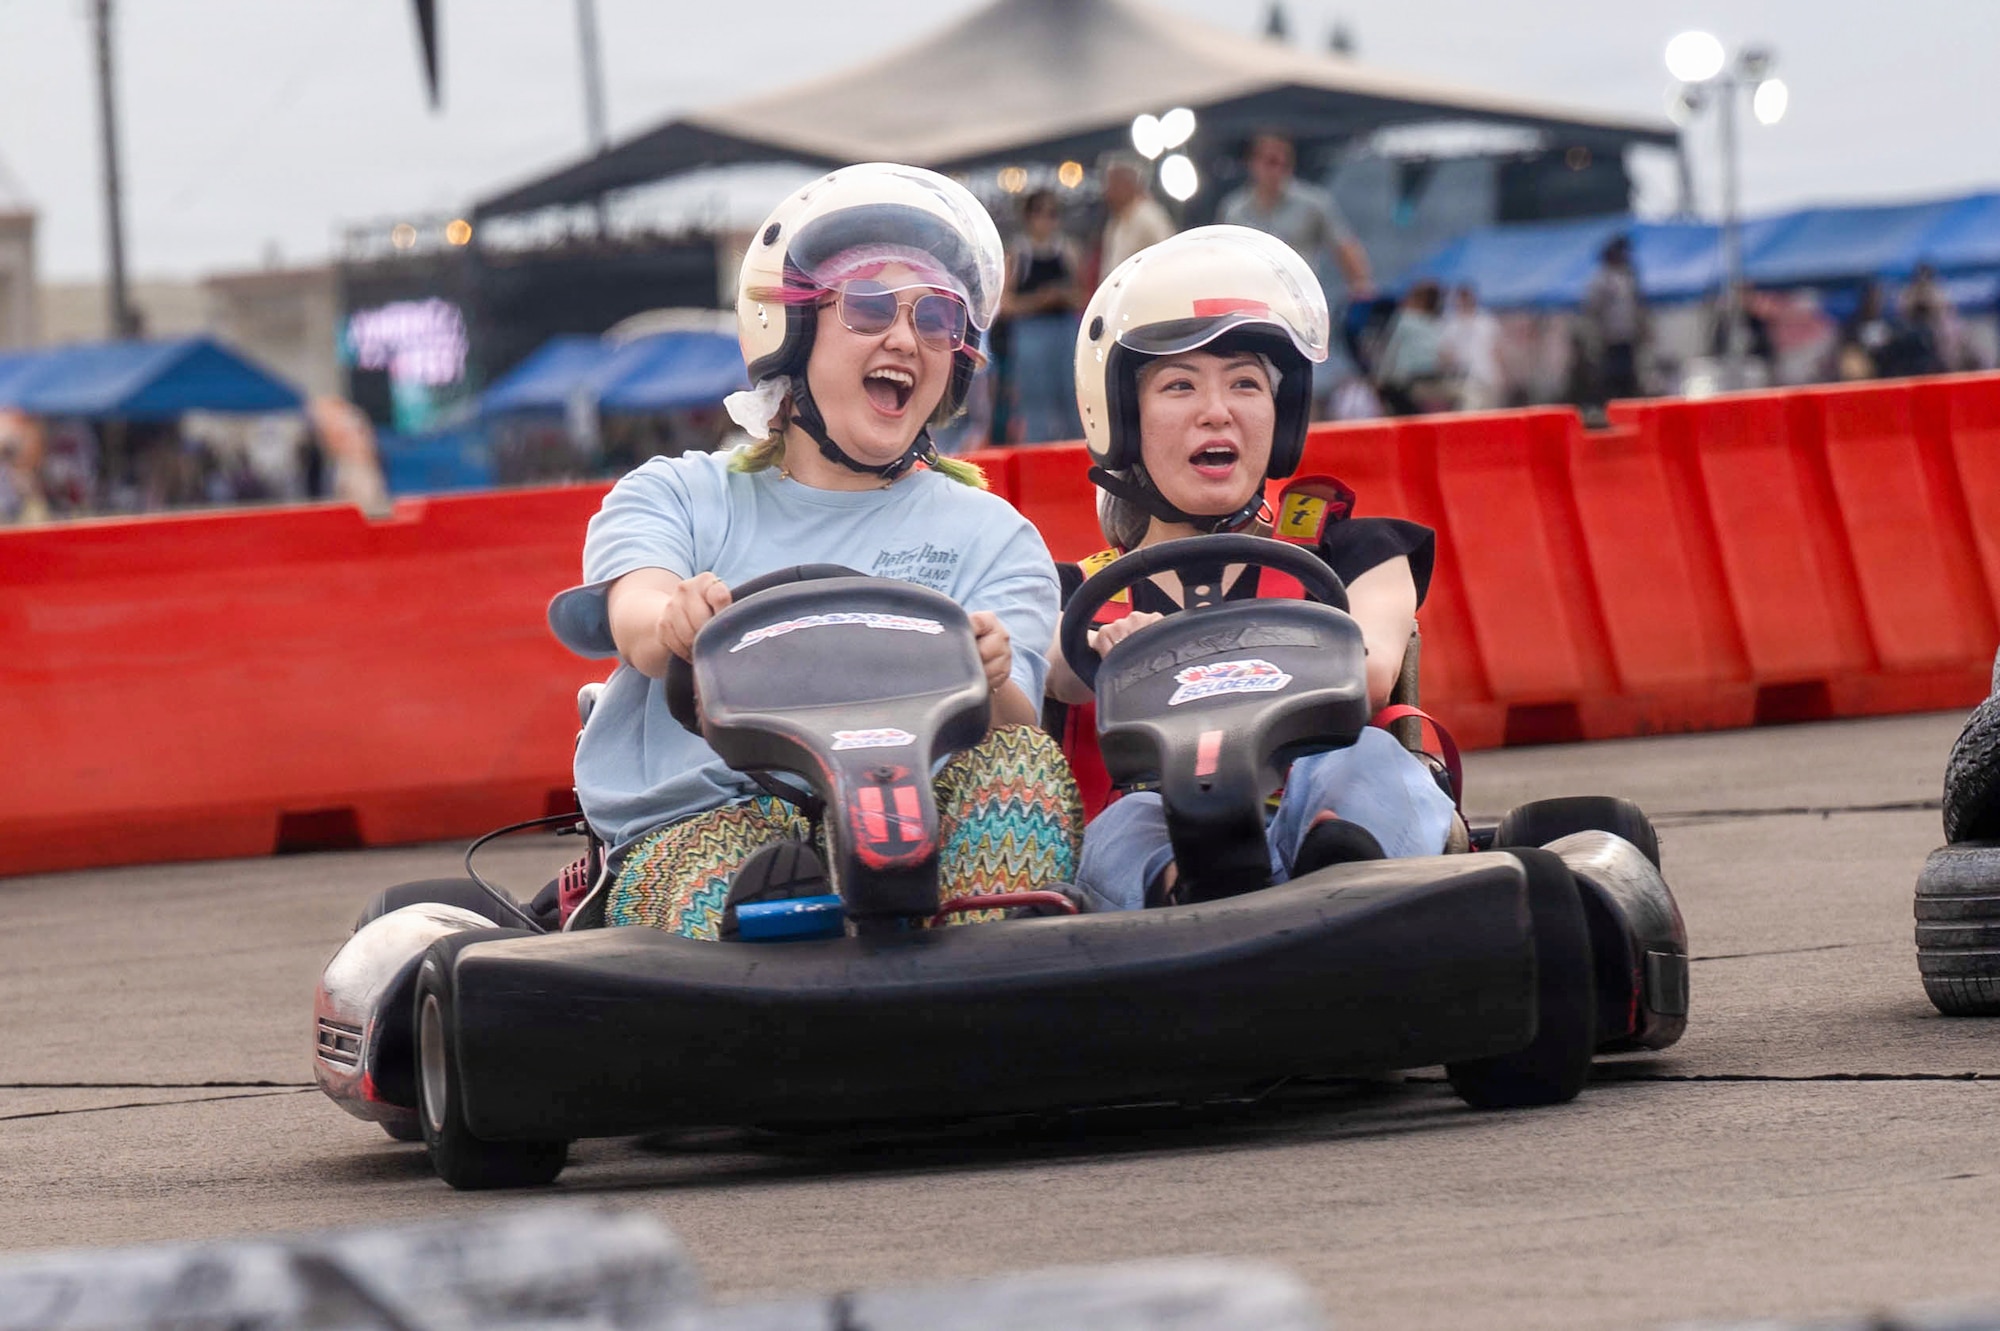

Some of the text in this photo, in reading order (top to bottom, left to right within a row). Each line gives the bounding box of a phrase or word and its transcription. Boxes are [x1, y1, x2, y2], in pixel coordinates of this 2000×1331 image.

[873, 542, 958, 568] Peter Pan's
[919, 565, 951, 580] LAND
[1180, 677, 1280, 699] SCUDERIA
